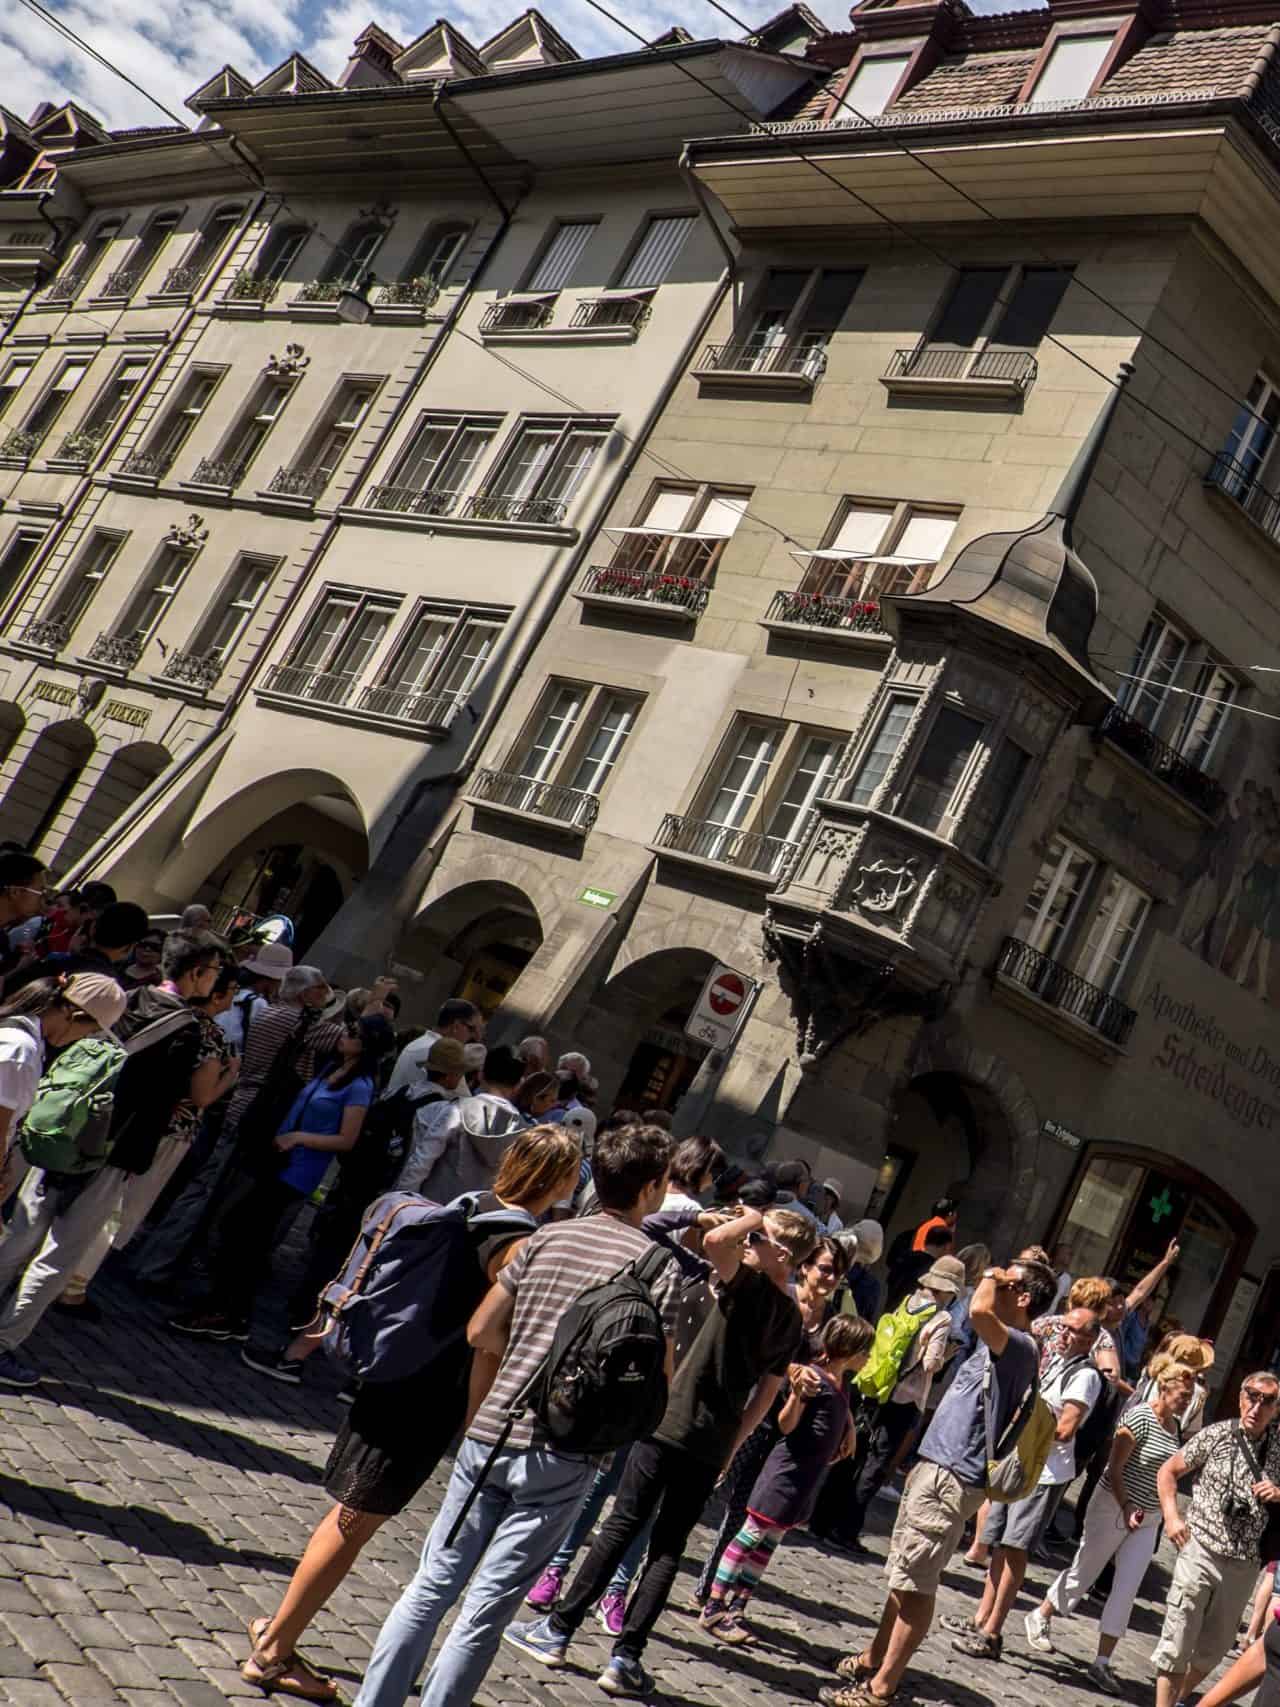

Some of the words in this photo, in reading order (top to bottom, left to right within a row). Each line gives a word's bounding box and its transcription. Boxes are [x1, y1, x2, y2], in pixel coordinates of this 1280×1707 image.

[1144, 982, 1225, 1050] Apotheke
[1224, 1040, 1252, 1067] und
[1152, 1032, 1280, 1129] Scheidegger
